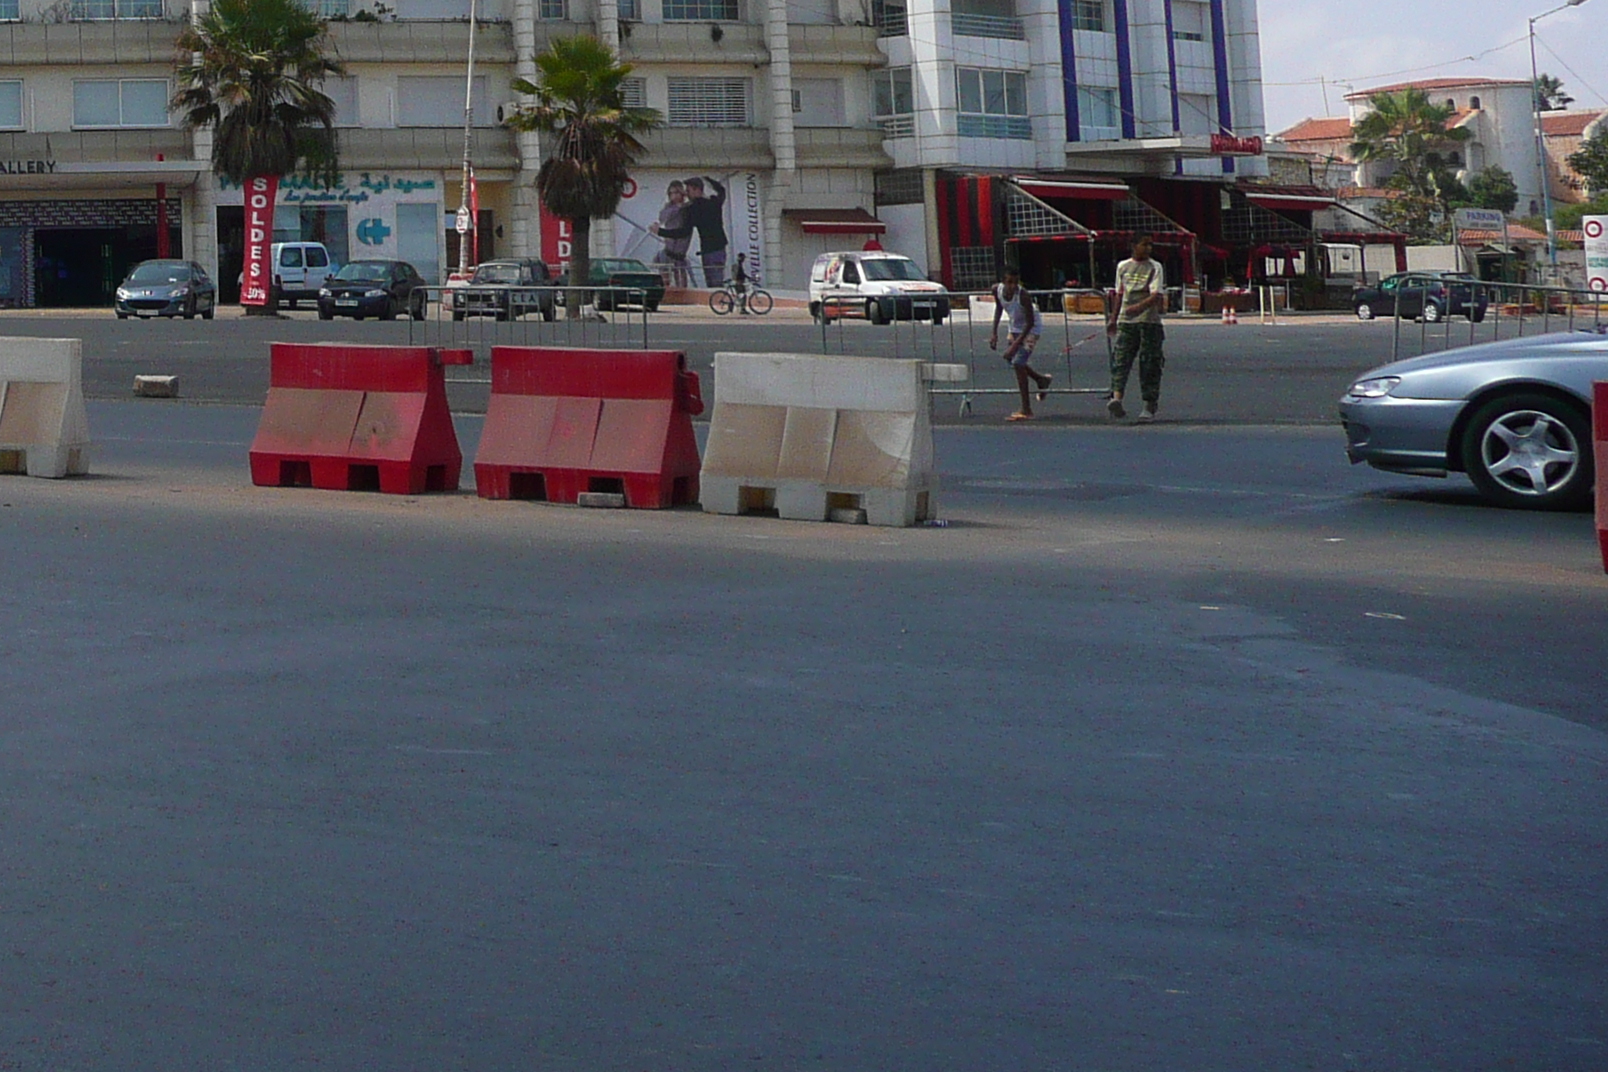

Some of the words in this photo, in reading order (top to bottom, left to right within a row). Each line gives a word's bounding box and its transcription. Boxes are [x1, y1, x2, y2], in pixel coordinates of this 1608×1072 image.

[250, 177, 268, 277] SOLDES
[746, 172, 759, 241] COLLECTION
[1466, 211, 1501, 222] PARKING
